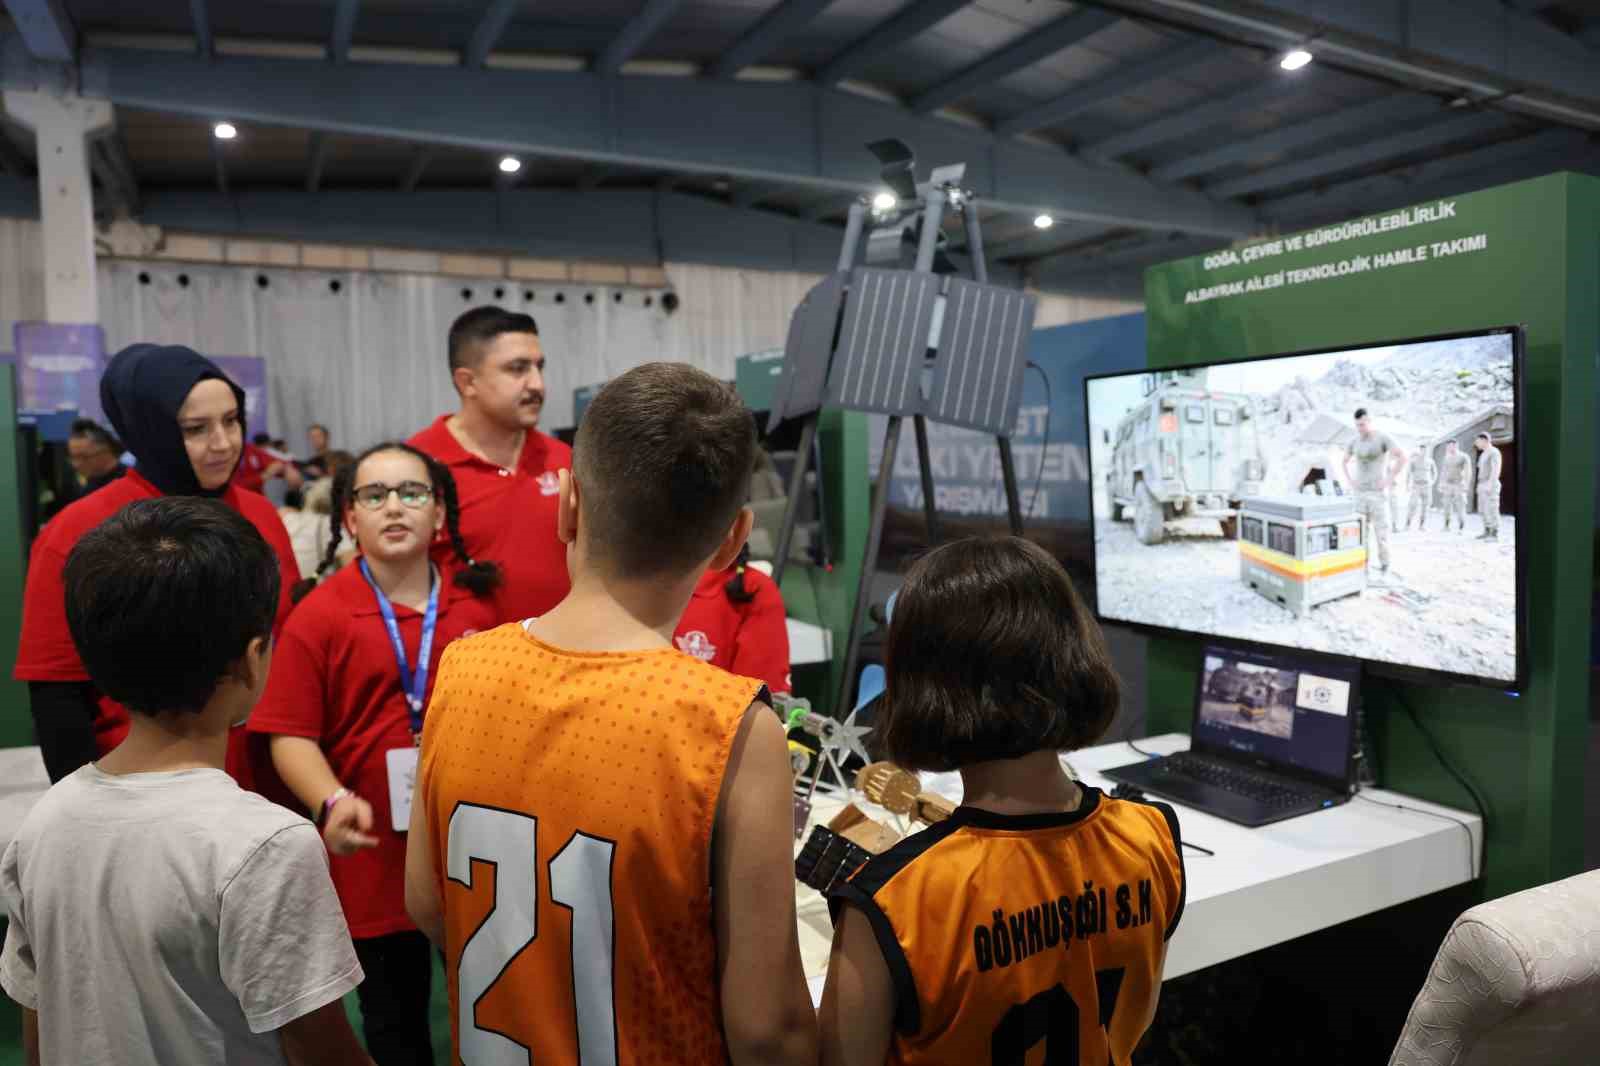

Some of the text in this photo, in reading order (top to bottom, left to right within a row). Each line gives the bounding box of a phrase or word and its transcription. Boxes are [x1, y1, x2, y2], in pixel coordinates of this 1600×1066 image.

[1284, 236, 1304, 252] VE
[1305, 201, 1456, 248] SÜRDÜRÜLEBİLİRLİK
[1286, 255, 1371, 284] TEKNOLOJİK
[1373, 245, 1428, 268] HAMLE
[1431, 234, 1487, 257] TAKIMI
[446, 801, 619, 1066] 21
